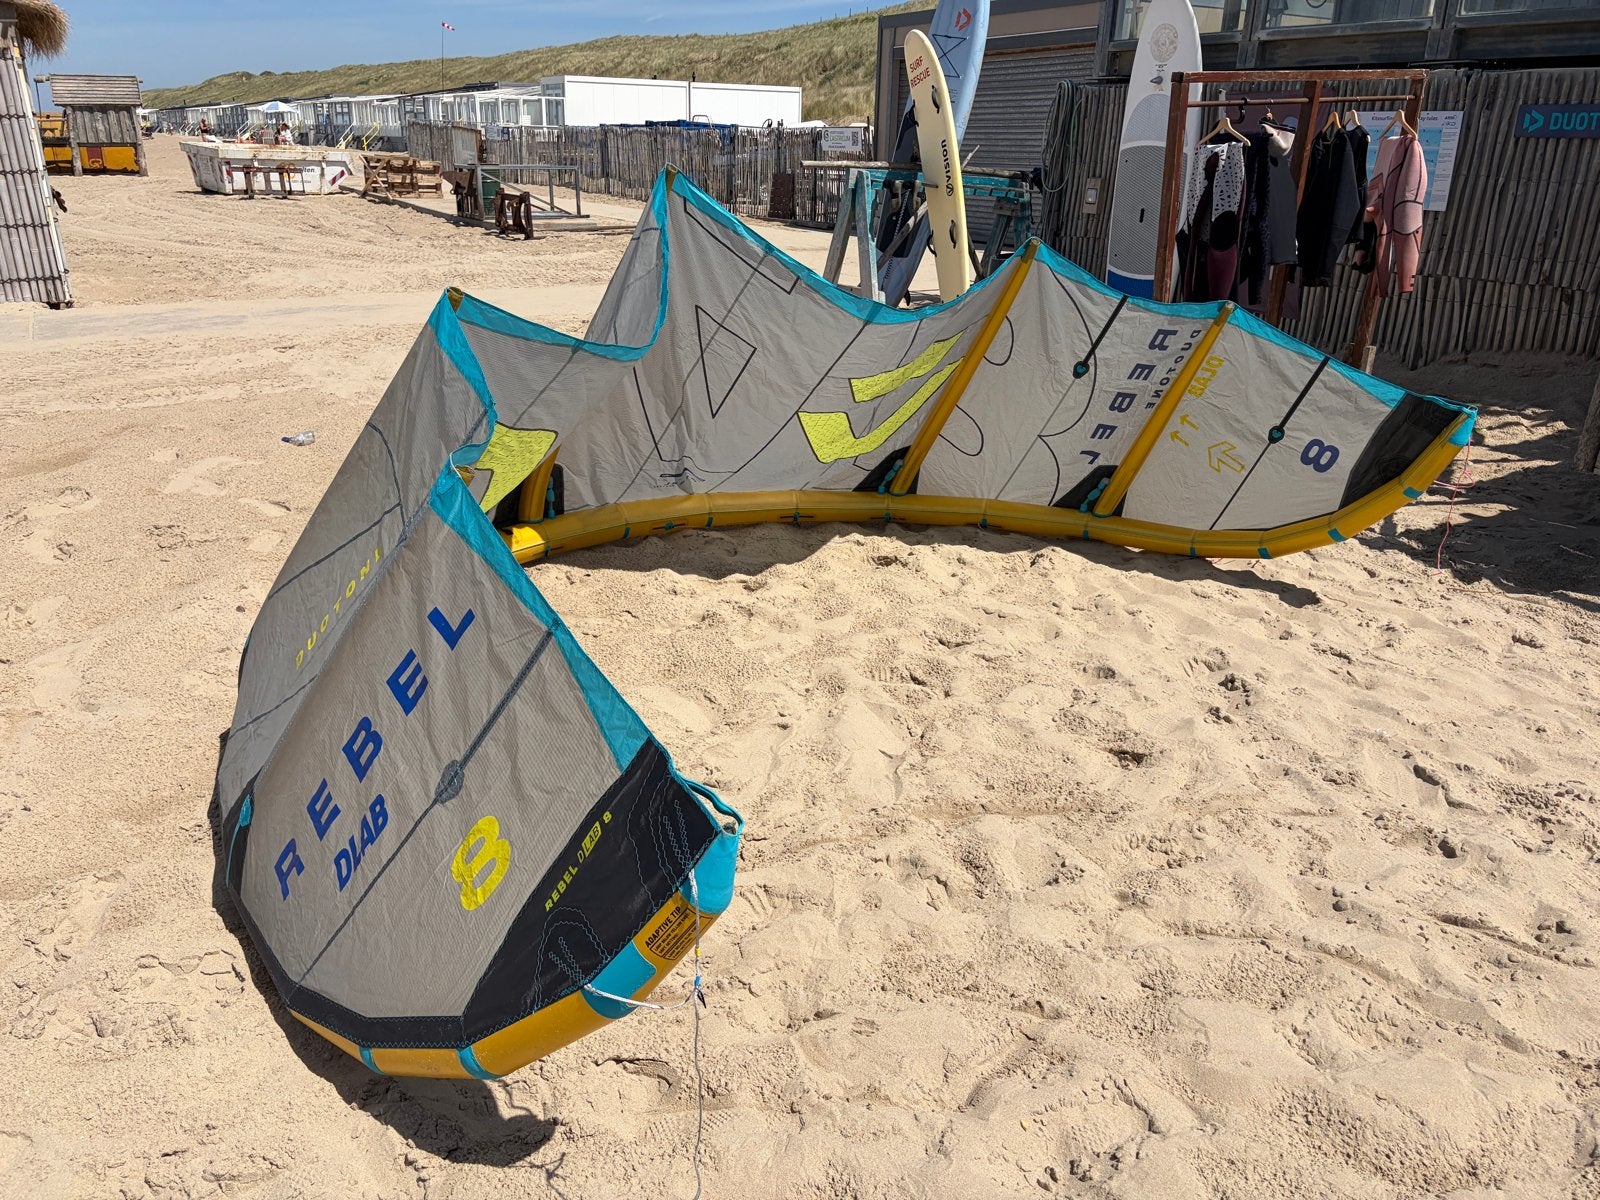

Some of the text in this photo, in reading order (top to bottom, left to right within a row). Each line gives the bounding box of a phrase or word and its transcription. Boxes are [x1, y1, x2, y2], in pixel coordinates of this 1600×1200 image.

[910, 56, 923, 73] SURF
[910, 67, 931, 88] RESCUE
[1549, 112, 1600, 130] DUOT
[274, 606, 475, 901] REBEL
[333, 794, 389, 892] DLAB
[451, 815, 511, 911] 8
[545, 865, 578, 912] REBEL
[602, 810, 613, 824] 8
[645, 906, 681, 948] ADAPTIVE TIP
